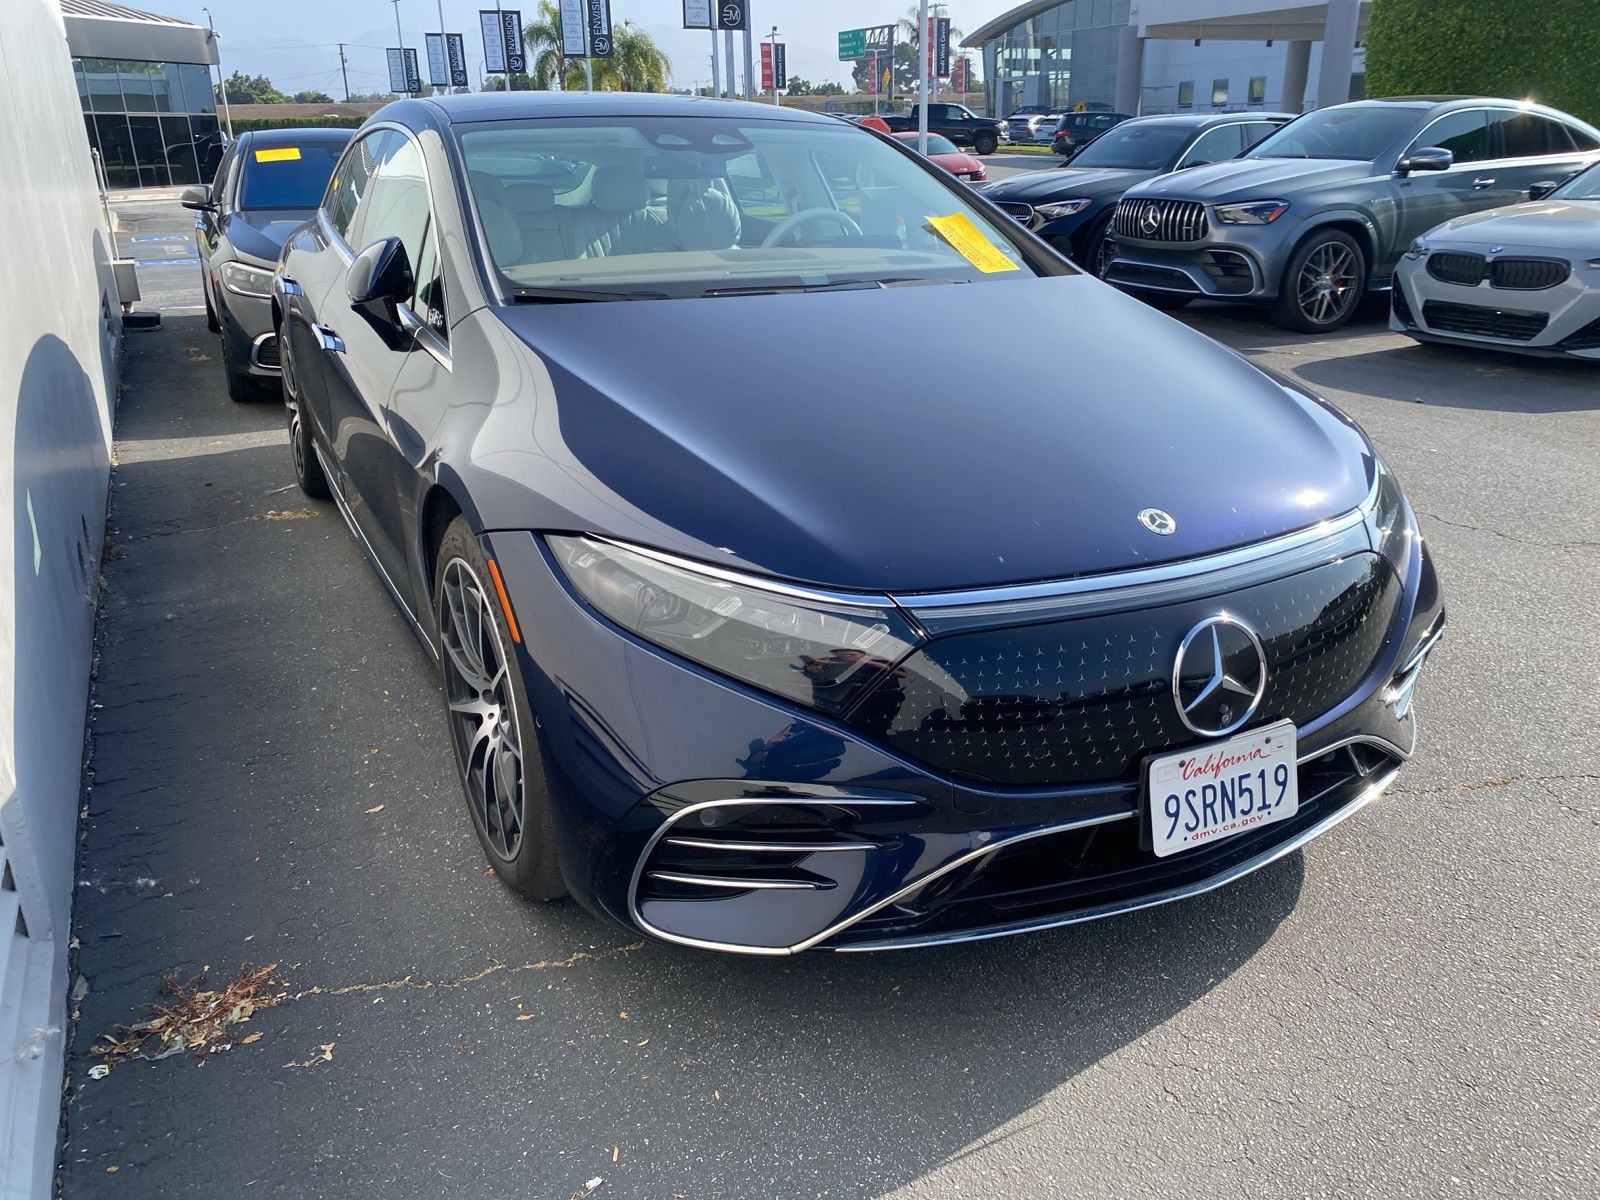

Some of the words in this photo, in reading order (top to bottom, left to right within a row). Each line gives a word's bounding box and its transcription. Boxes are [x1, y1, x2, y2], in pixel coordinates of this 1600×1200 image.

[505, 13, 516, 55] ENVISION
[448, 36, 459, 71] ENVISION
[1182, 747, 1271, 780] California
[1164, 763, 1288, 840] 9SRN519
[1191, 814, 1264, 841] dmv.ca.gov
